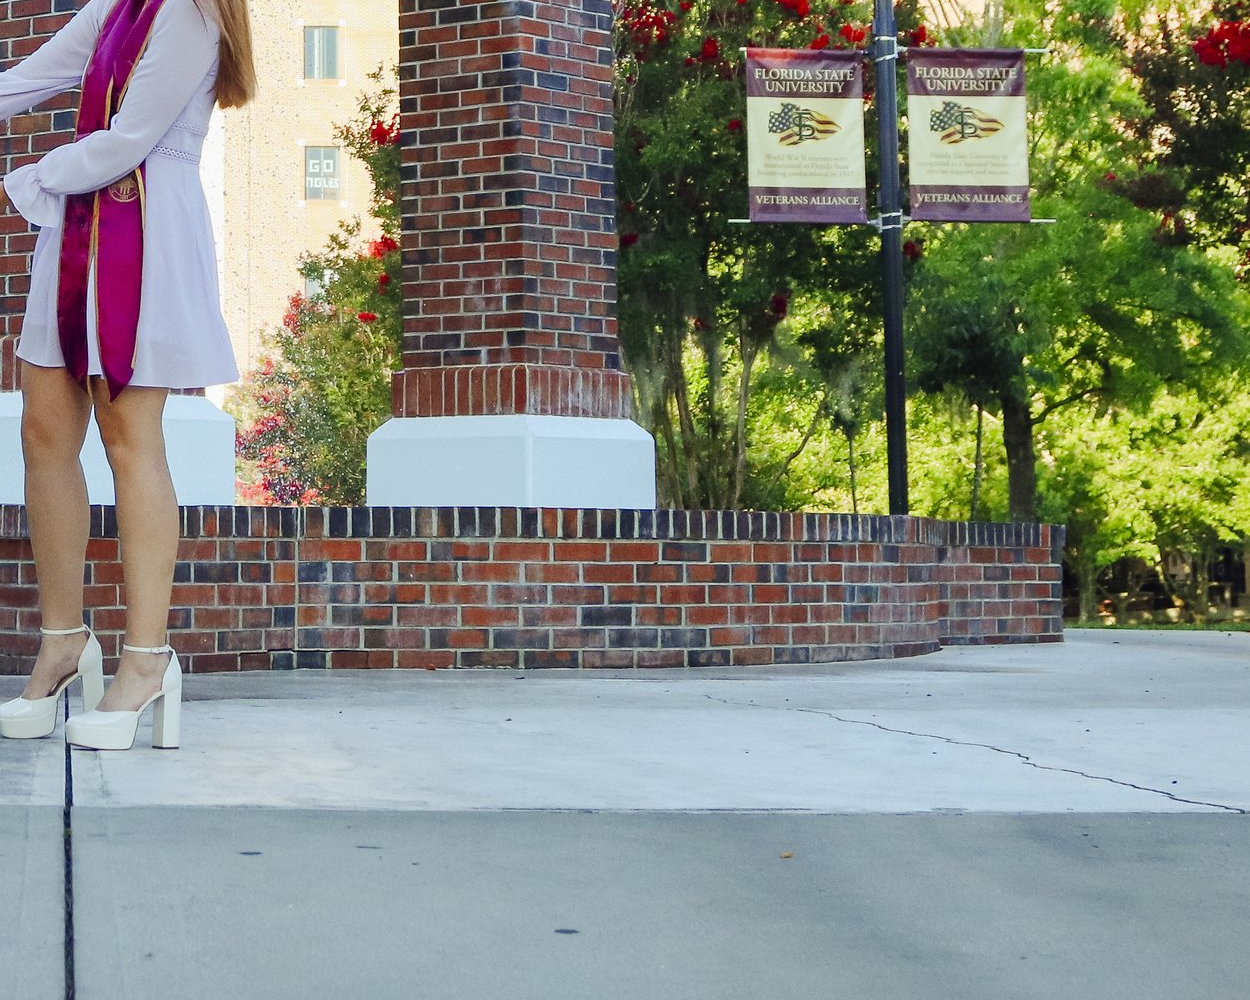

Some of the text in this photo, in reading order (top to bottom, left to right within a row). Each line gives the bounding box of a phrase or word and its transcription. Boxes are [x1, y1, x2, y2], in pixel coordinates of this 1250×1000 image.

[754, 68, 855, 81] FLORIDA STATE
[915, 66, 1018, 79] FLORIDA STATE
[765, 81, 845, 93] UNIVERSITY
[926, 79, 1006, 91] UNIVERSITY
[309, 160, 333, 173] GO
[755, 195, 860, 206] VETERANS ALLIANCE
[916, 193, 1023, 203] VETERANS ALLIANCE
